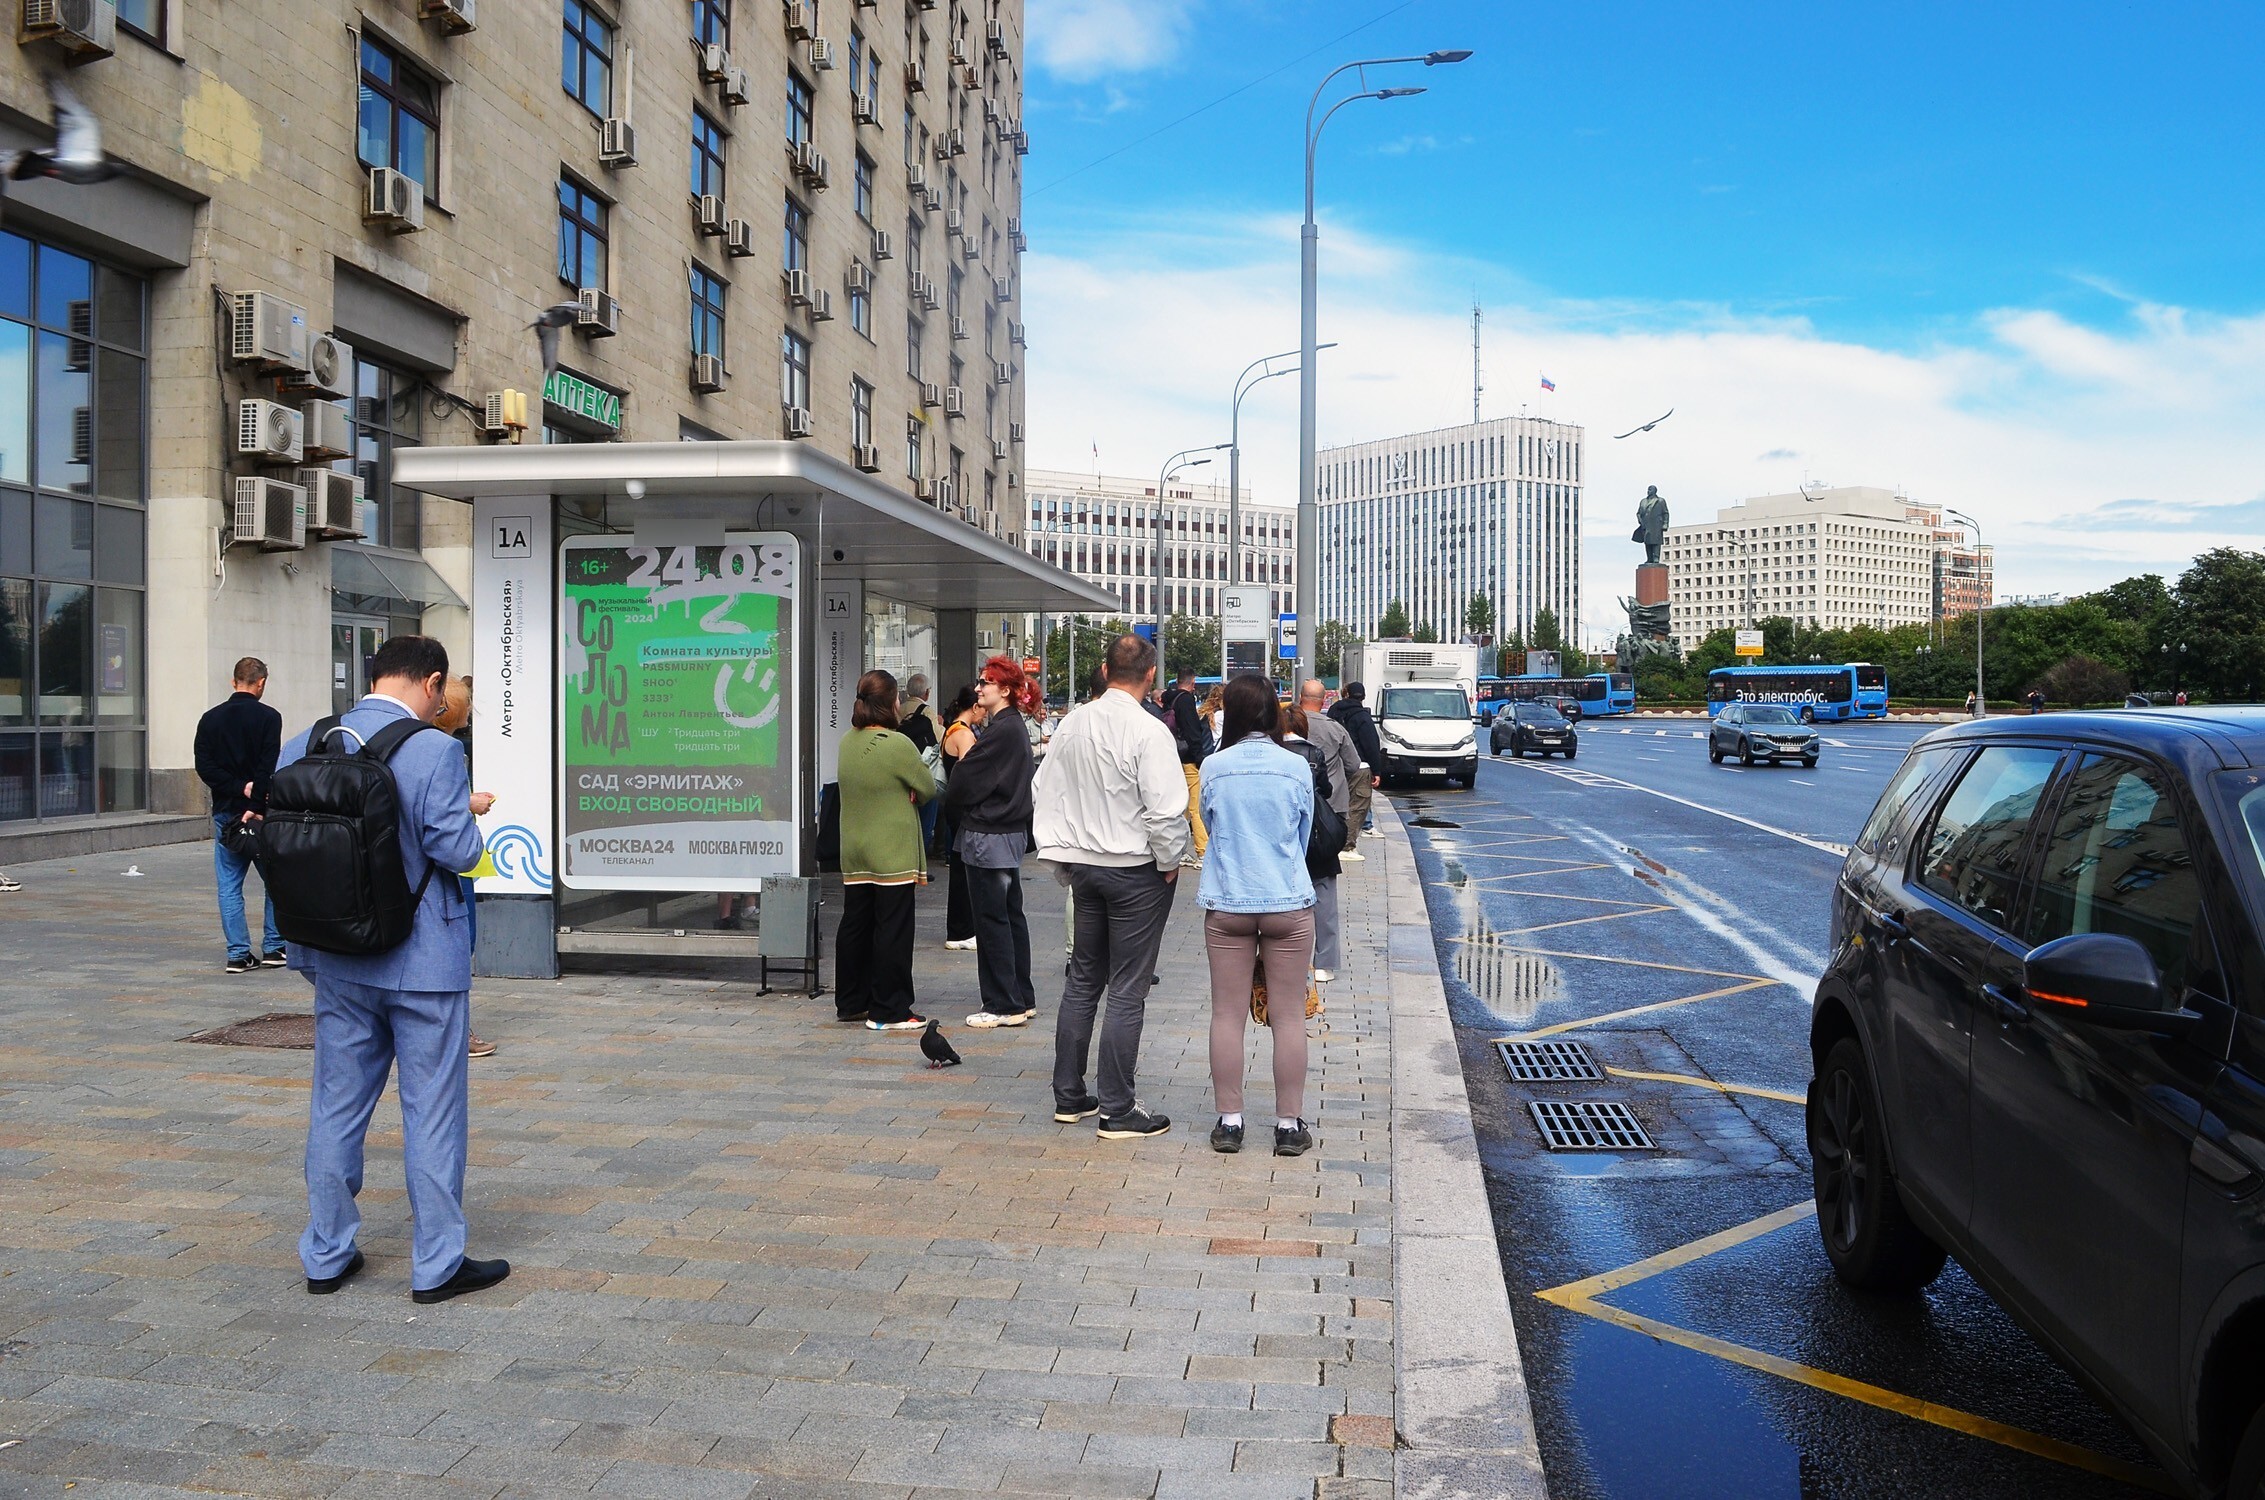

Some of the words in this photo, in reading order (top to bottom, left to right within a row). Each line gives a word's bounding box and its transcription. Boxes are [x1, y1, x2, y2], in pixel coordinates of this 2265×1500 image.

[543, 369, 619, 429] АПТЕКА
[580, 559, 610, 575] 16+
[625, 544, 793, 588] 24.08
[598, 597, 653, 606] музыкальный
[598, 605, 641, 614] фестиваль
[515, 579, 525, 643] Oktyabrskaya
[624, 614, 654, 624] 2024
[500, 580, 515, 687] «Октябрьская»
[515, 644, 524, 674] Metro
[643, 646, 701, 656] Комната
[706, 647, 773, 658] культуры
[643, 663, 712, 672] PASSMURNY
[829, 631, 839, 697] «Октябрьская»
[1735, 688, 1756, 703] Это
[1757, 689, 1828, 706] электробус.
[501, 690, 515, 738] Метро
[642, 709, 675, 718] Антон
[679, 709, 744, 720] Лаврентьев
[829, 699, 839, 729] Метро
[674, 728, 720, 739] Тридцать
[723, 729, 741, 739] три
[674, 743, 720, 752] тридцать
[722, 743, 740, 752] три
[578, 774, 620, 791] САД
[624, 774, 744, 791] «ЭРМИТАЖ»
[578, 796, 631, 814] ВХОД
[636, 793, 762, 815] СВОБОДНЫЙ
[688, 840, 737, 855] МОСКВА
[739, 841, 758, 855] FM
[760, 842, 784, 856] 92.0
[602, 857, 654, 865] ТЕЛЕКАНАЛ
